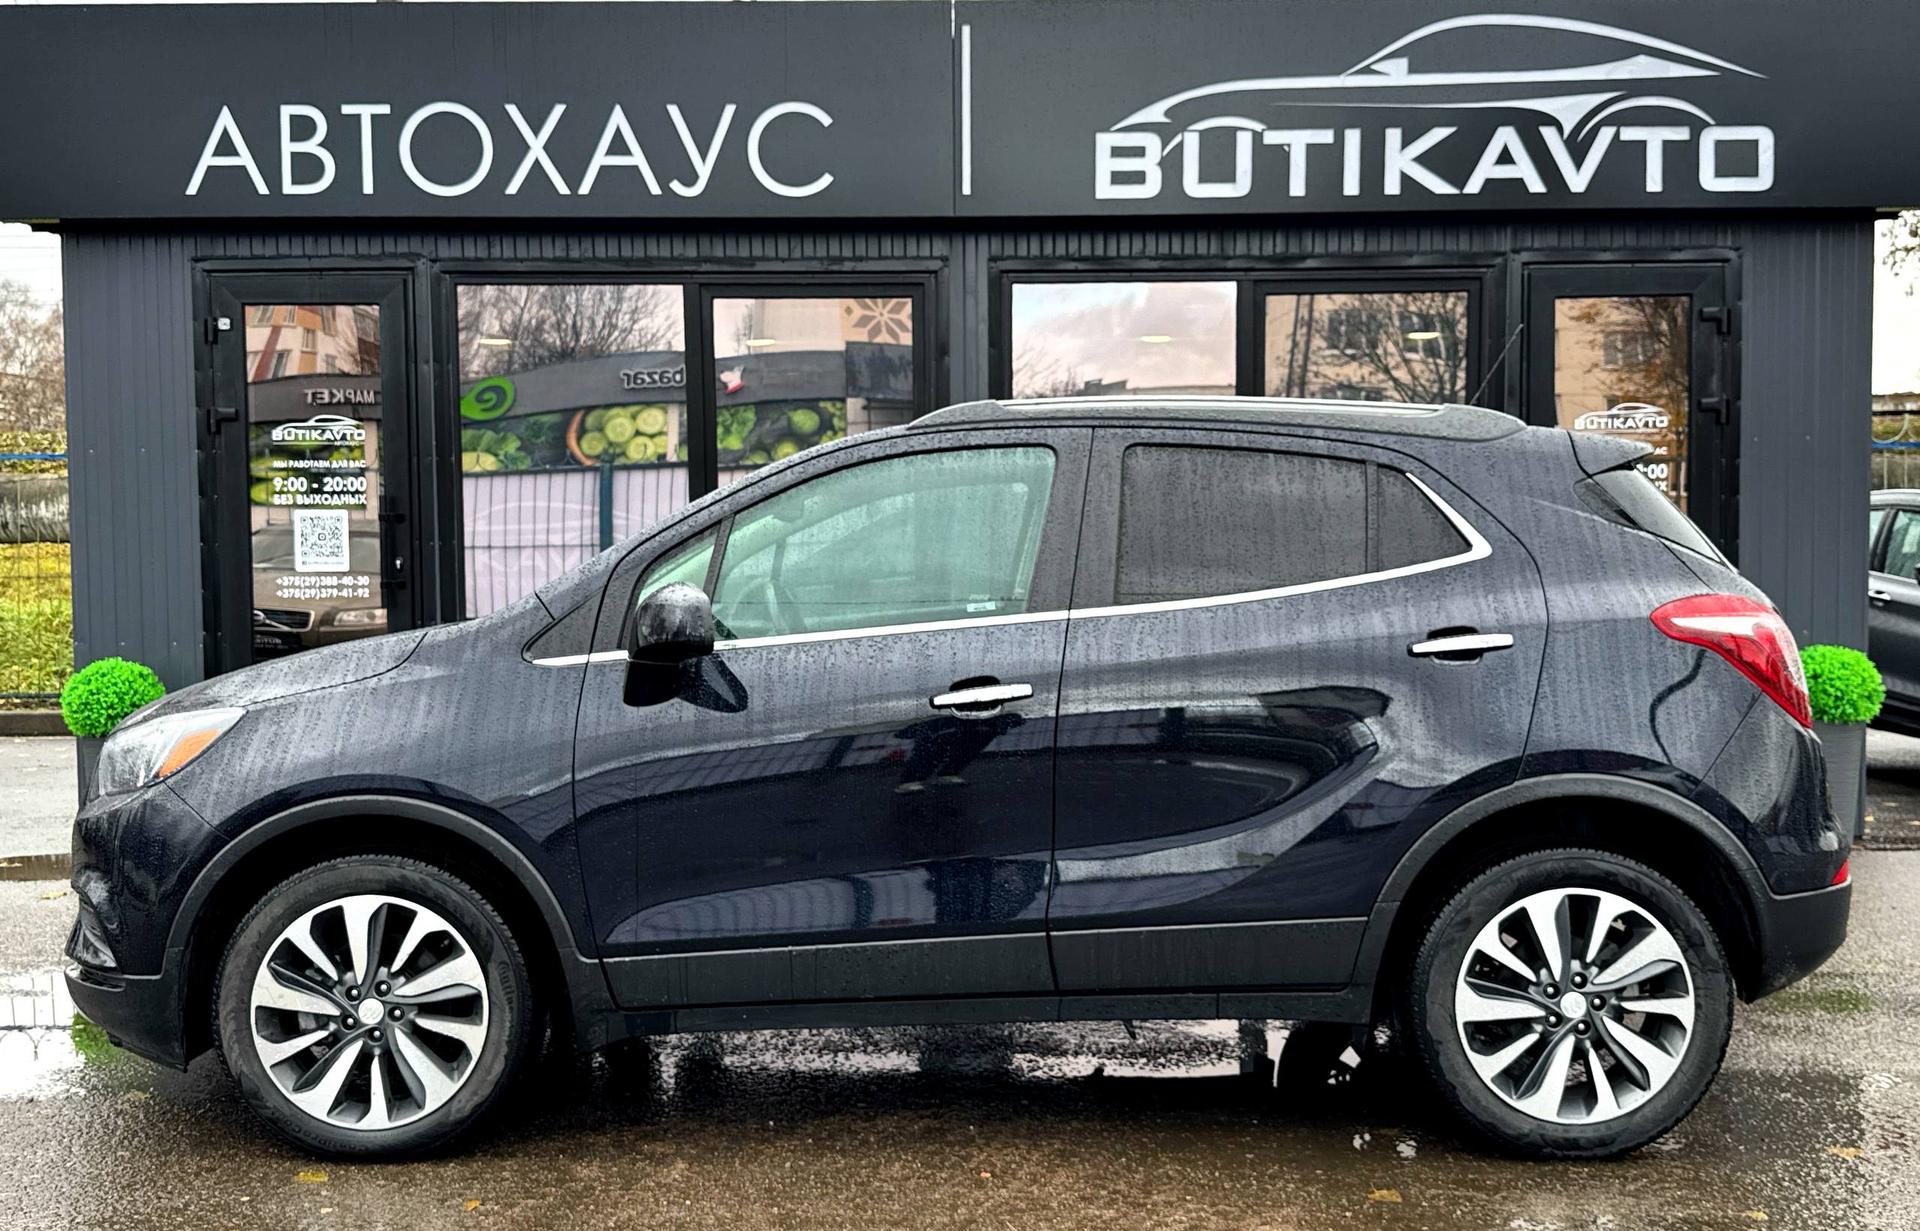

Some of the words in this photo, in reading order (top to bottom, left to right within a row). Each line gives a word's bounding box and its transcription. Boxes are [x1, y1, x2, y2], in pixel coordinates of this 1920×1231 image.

[185, 101, 834, 198] АВТОХАУС
[1095, 124, 1775, 199] BUTIKAVTO
[1574, 416, 1668, 429] BUTIKAVTO
[272, 428, 366, 441] BUTIKAVTO
[1653, 446, 1668, 455] АС
[272, 460, 287, 468] МЫ
[288, 460, 330, 468] РАБОТАЕМ
[348, 460, 366, 468] ВАС
[272, 476, 308, 492] 9:00
[322, 476, 367, 492] 20:00
[272, 494, 294, 505] БЕЗ
[295, 493, 367, 506] ВЫХОДНЫХ
